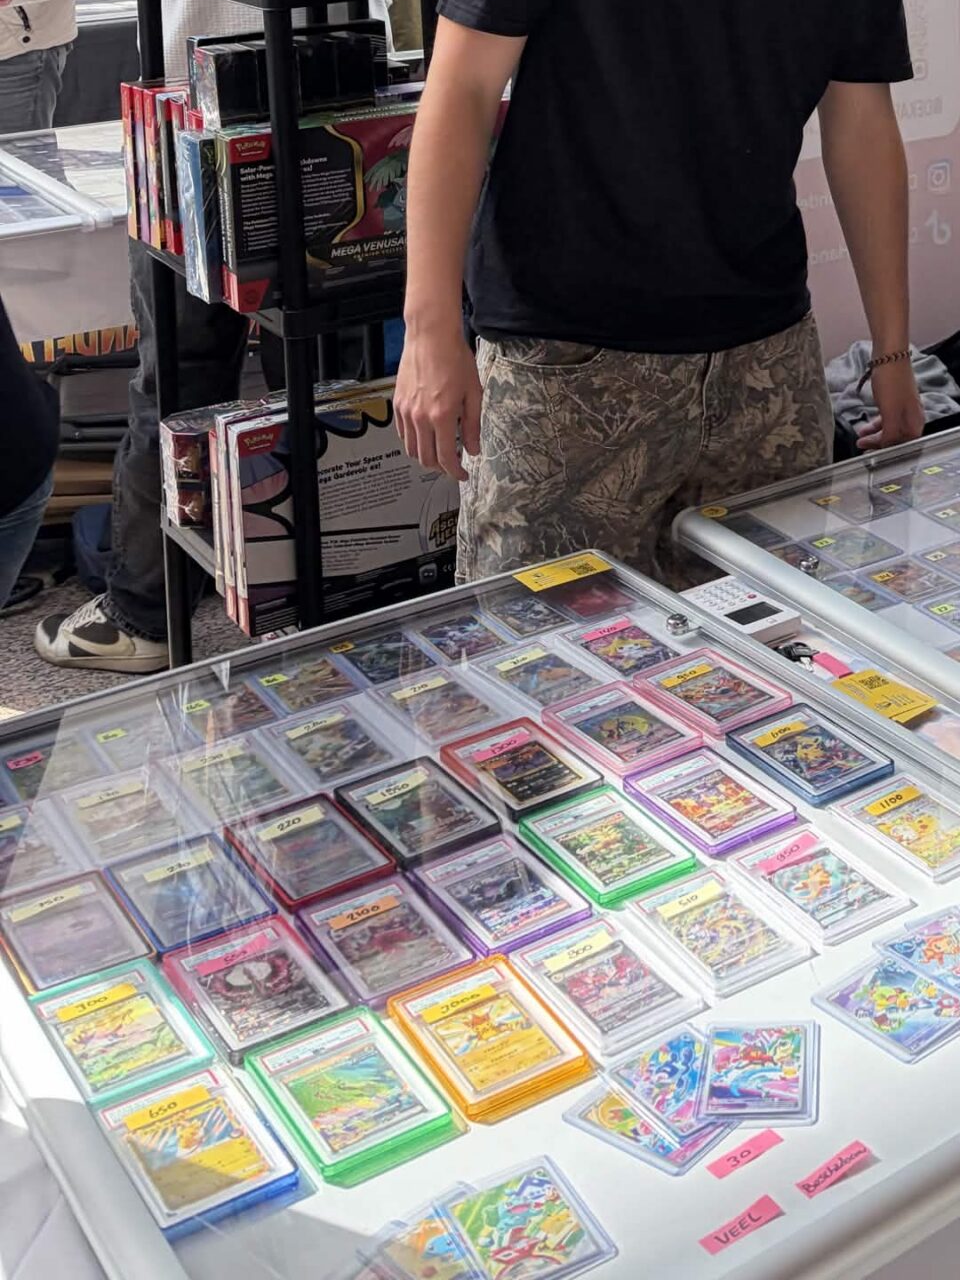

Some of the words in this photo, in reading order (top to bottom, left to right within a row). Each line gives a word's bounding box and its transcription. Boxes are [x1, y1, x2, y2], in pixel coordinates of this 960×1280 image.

[331, 244, 361, 259] MEGA
[363, 237, 408, 252] VENUSA
[726, 1149, 752, 1168] 30
[713, 1212, 763, 1245] VEEL
